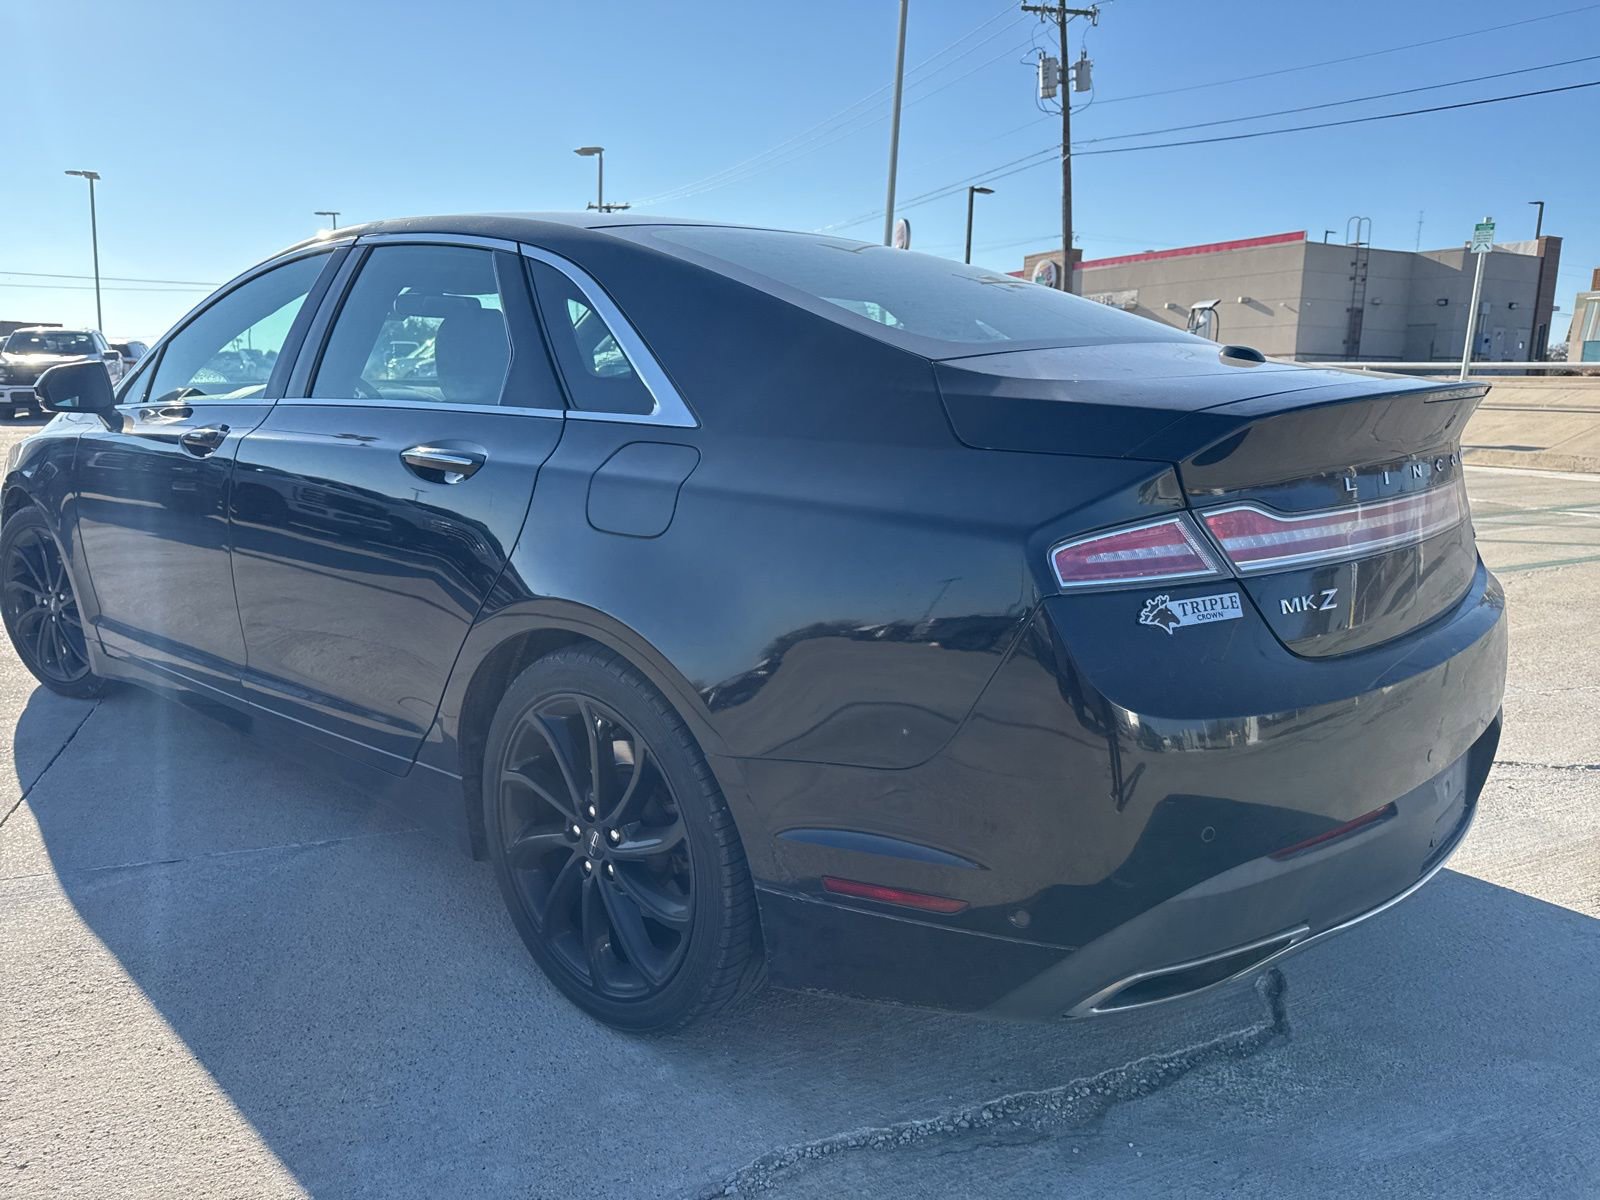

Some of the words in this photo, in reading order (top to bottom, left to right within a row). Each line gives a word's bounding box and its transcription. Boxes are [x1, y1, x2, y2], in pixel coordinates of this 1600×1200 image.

[1178, 595, 1239, 617] TRIPLE
[1279, 588, 1338, 615] MKZ
[1196, 611, 1224, 621] CROWN
